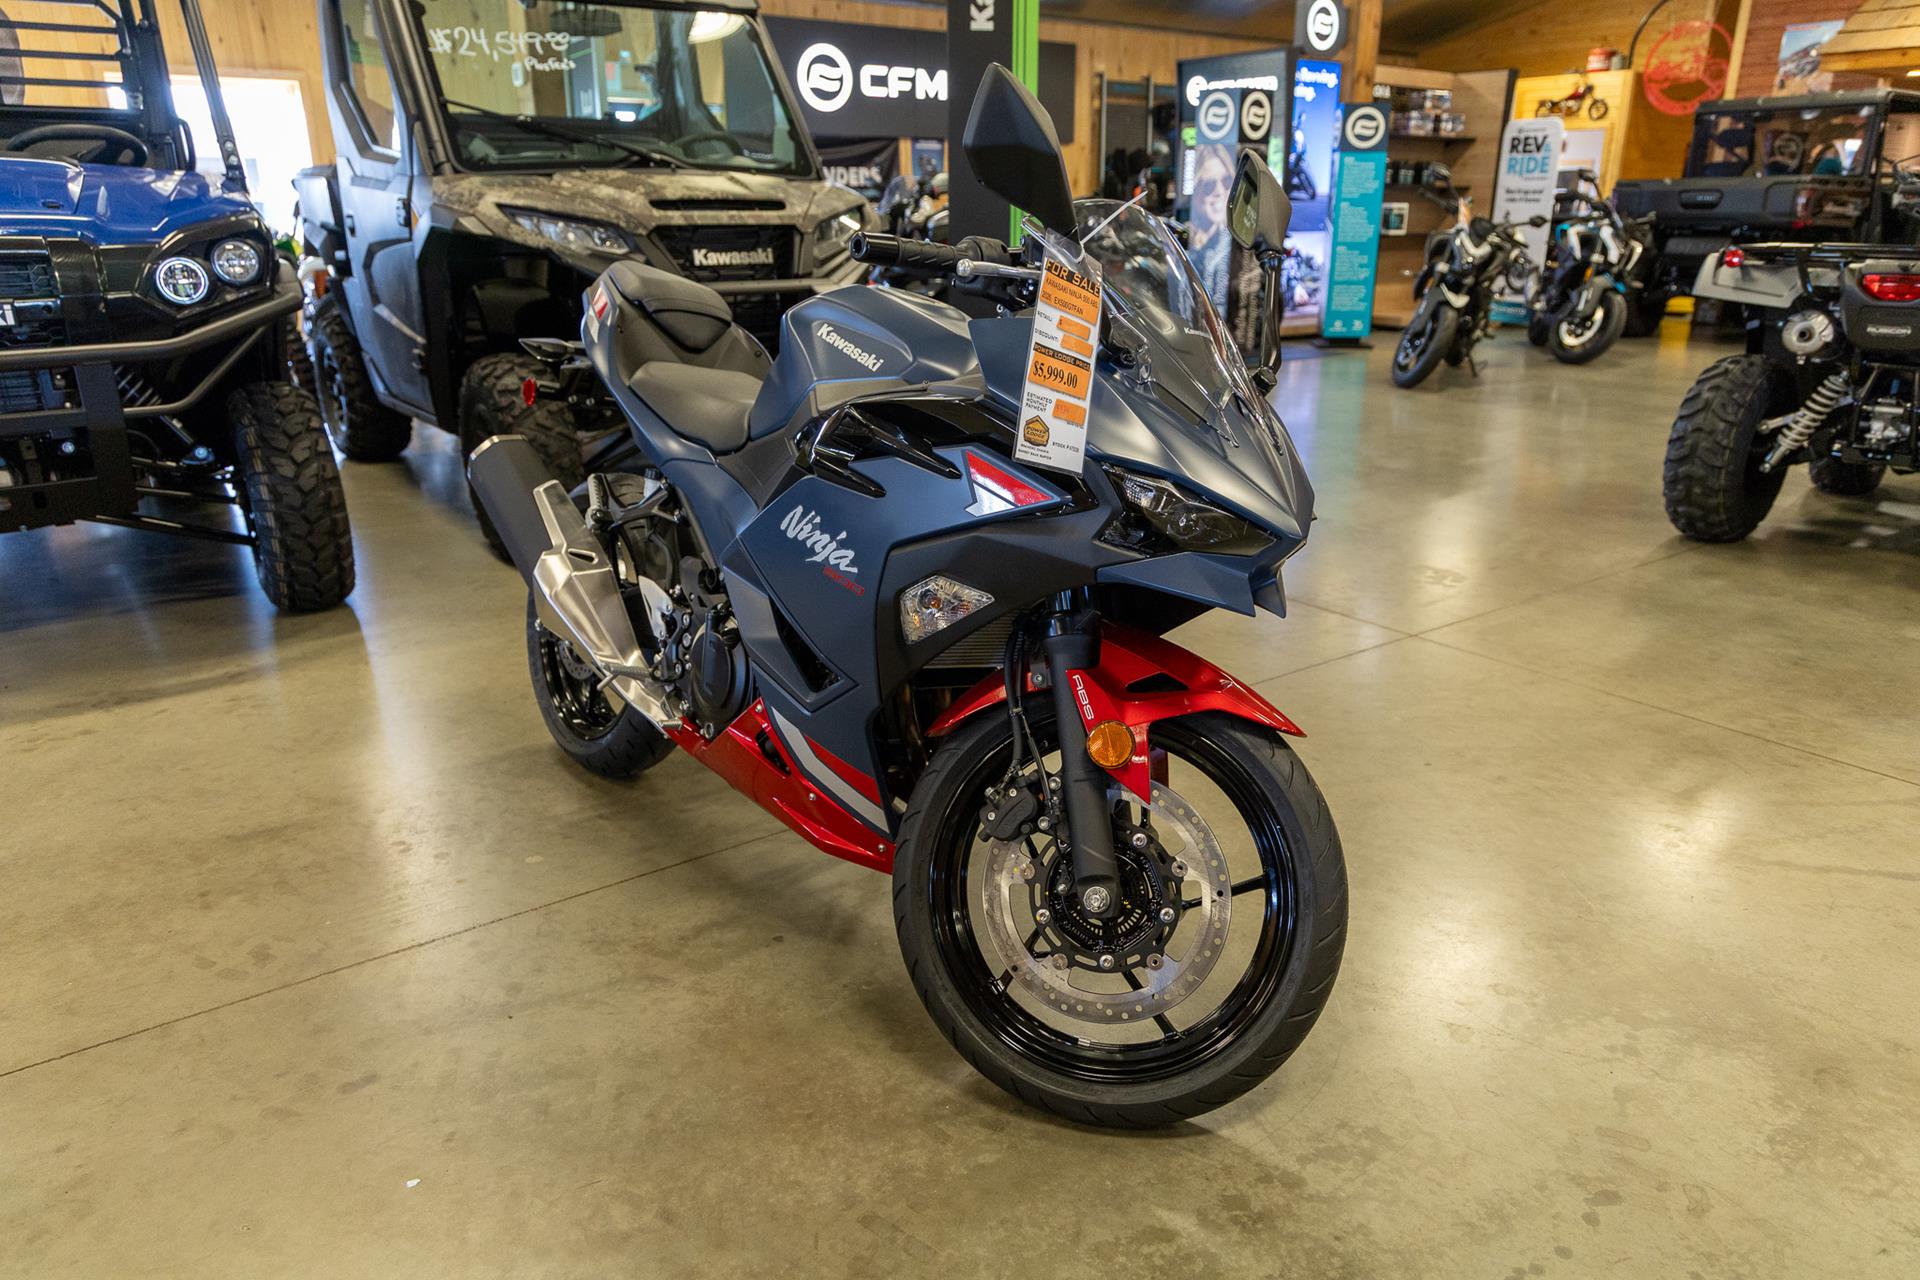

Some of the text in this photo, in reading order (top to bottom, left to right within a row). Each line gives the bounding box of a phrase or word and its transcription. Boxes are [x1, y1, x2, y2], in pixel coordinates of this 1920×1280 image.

[969, 0, 994, 31] K
[859, 64, 948, 101] CFM
[1509, 134, 1548, 154] REV
[1506, 156, 1550, 176] RIDE
[692, 247, 775, 267] Kawasaki
[1046, 259, 1100, 297] FOR SALE
[817, 323, 884, 372] Kawasaki
[1033, 360, 1078, 389] $5,999.00
[780, 505, 858, 573] Ninja
[1072, 674, 1094, 720] ABS
